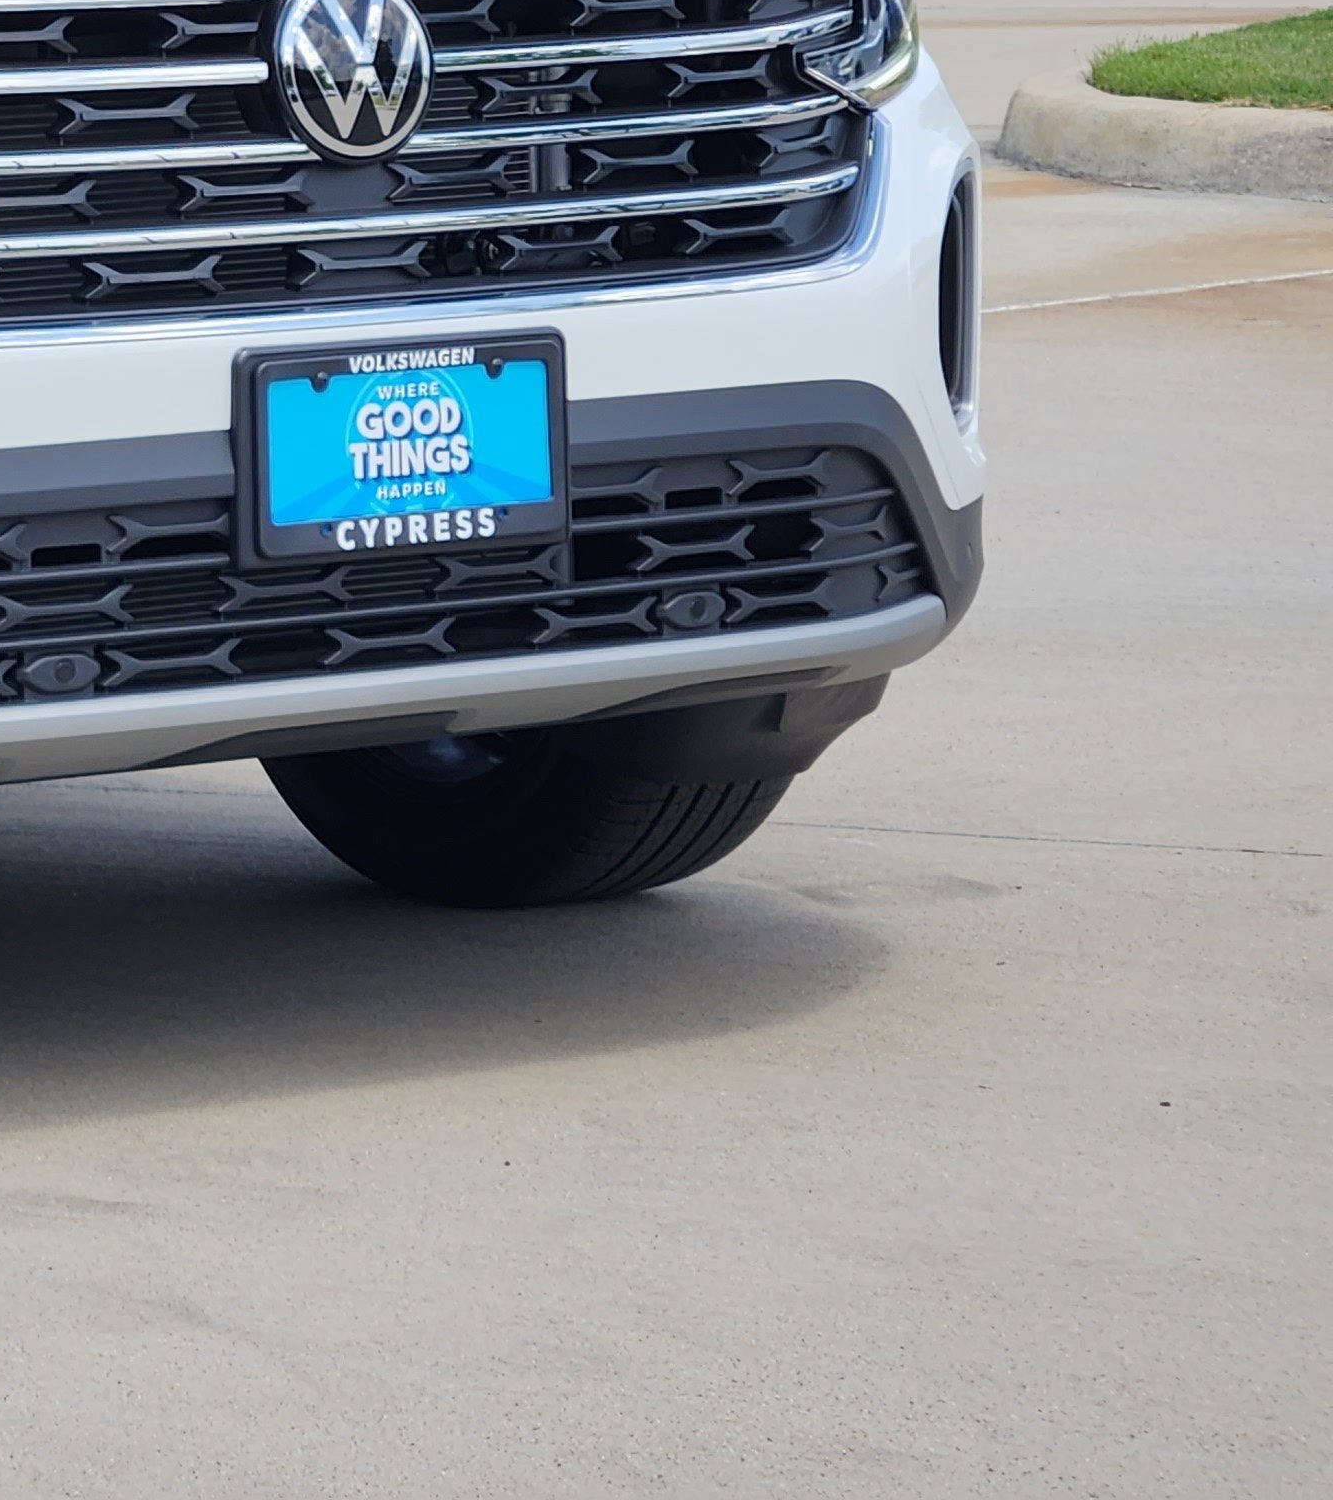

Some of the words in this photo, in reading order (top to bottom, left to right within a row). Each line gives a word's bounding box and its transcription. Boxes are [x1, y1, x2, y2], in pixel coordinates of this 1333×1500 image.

[349, 347, 475, 374] VOLKSWAGEN
[377, 381, 440, 399] WHERE
[356, 396, 461, 440] GOOD
[348, 434, 471, 480] THINGS
[376, 481, 447, 501] HAPPEN
[336, 507, 496, 551] CYPRESS
